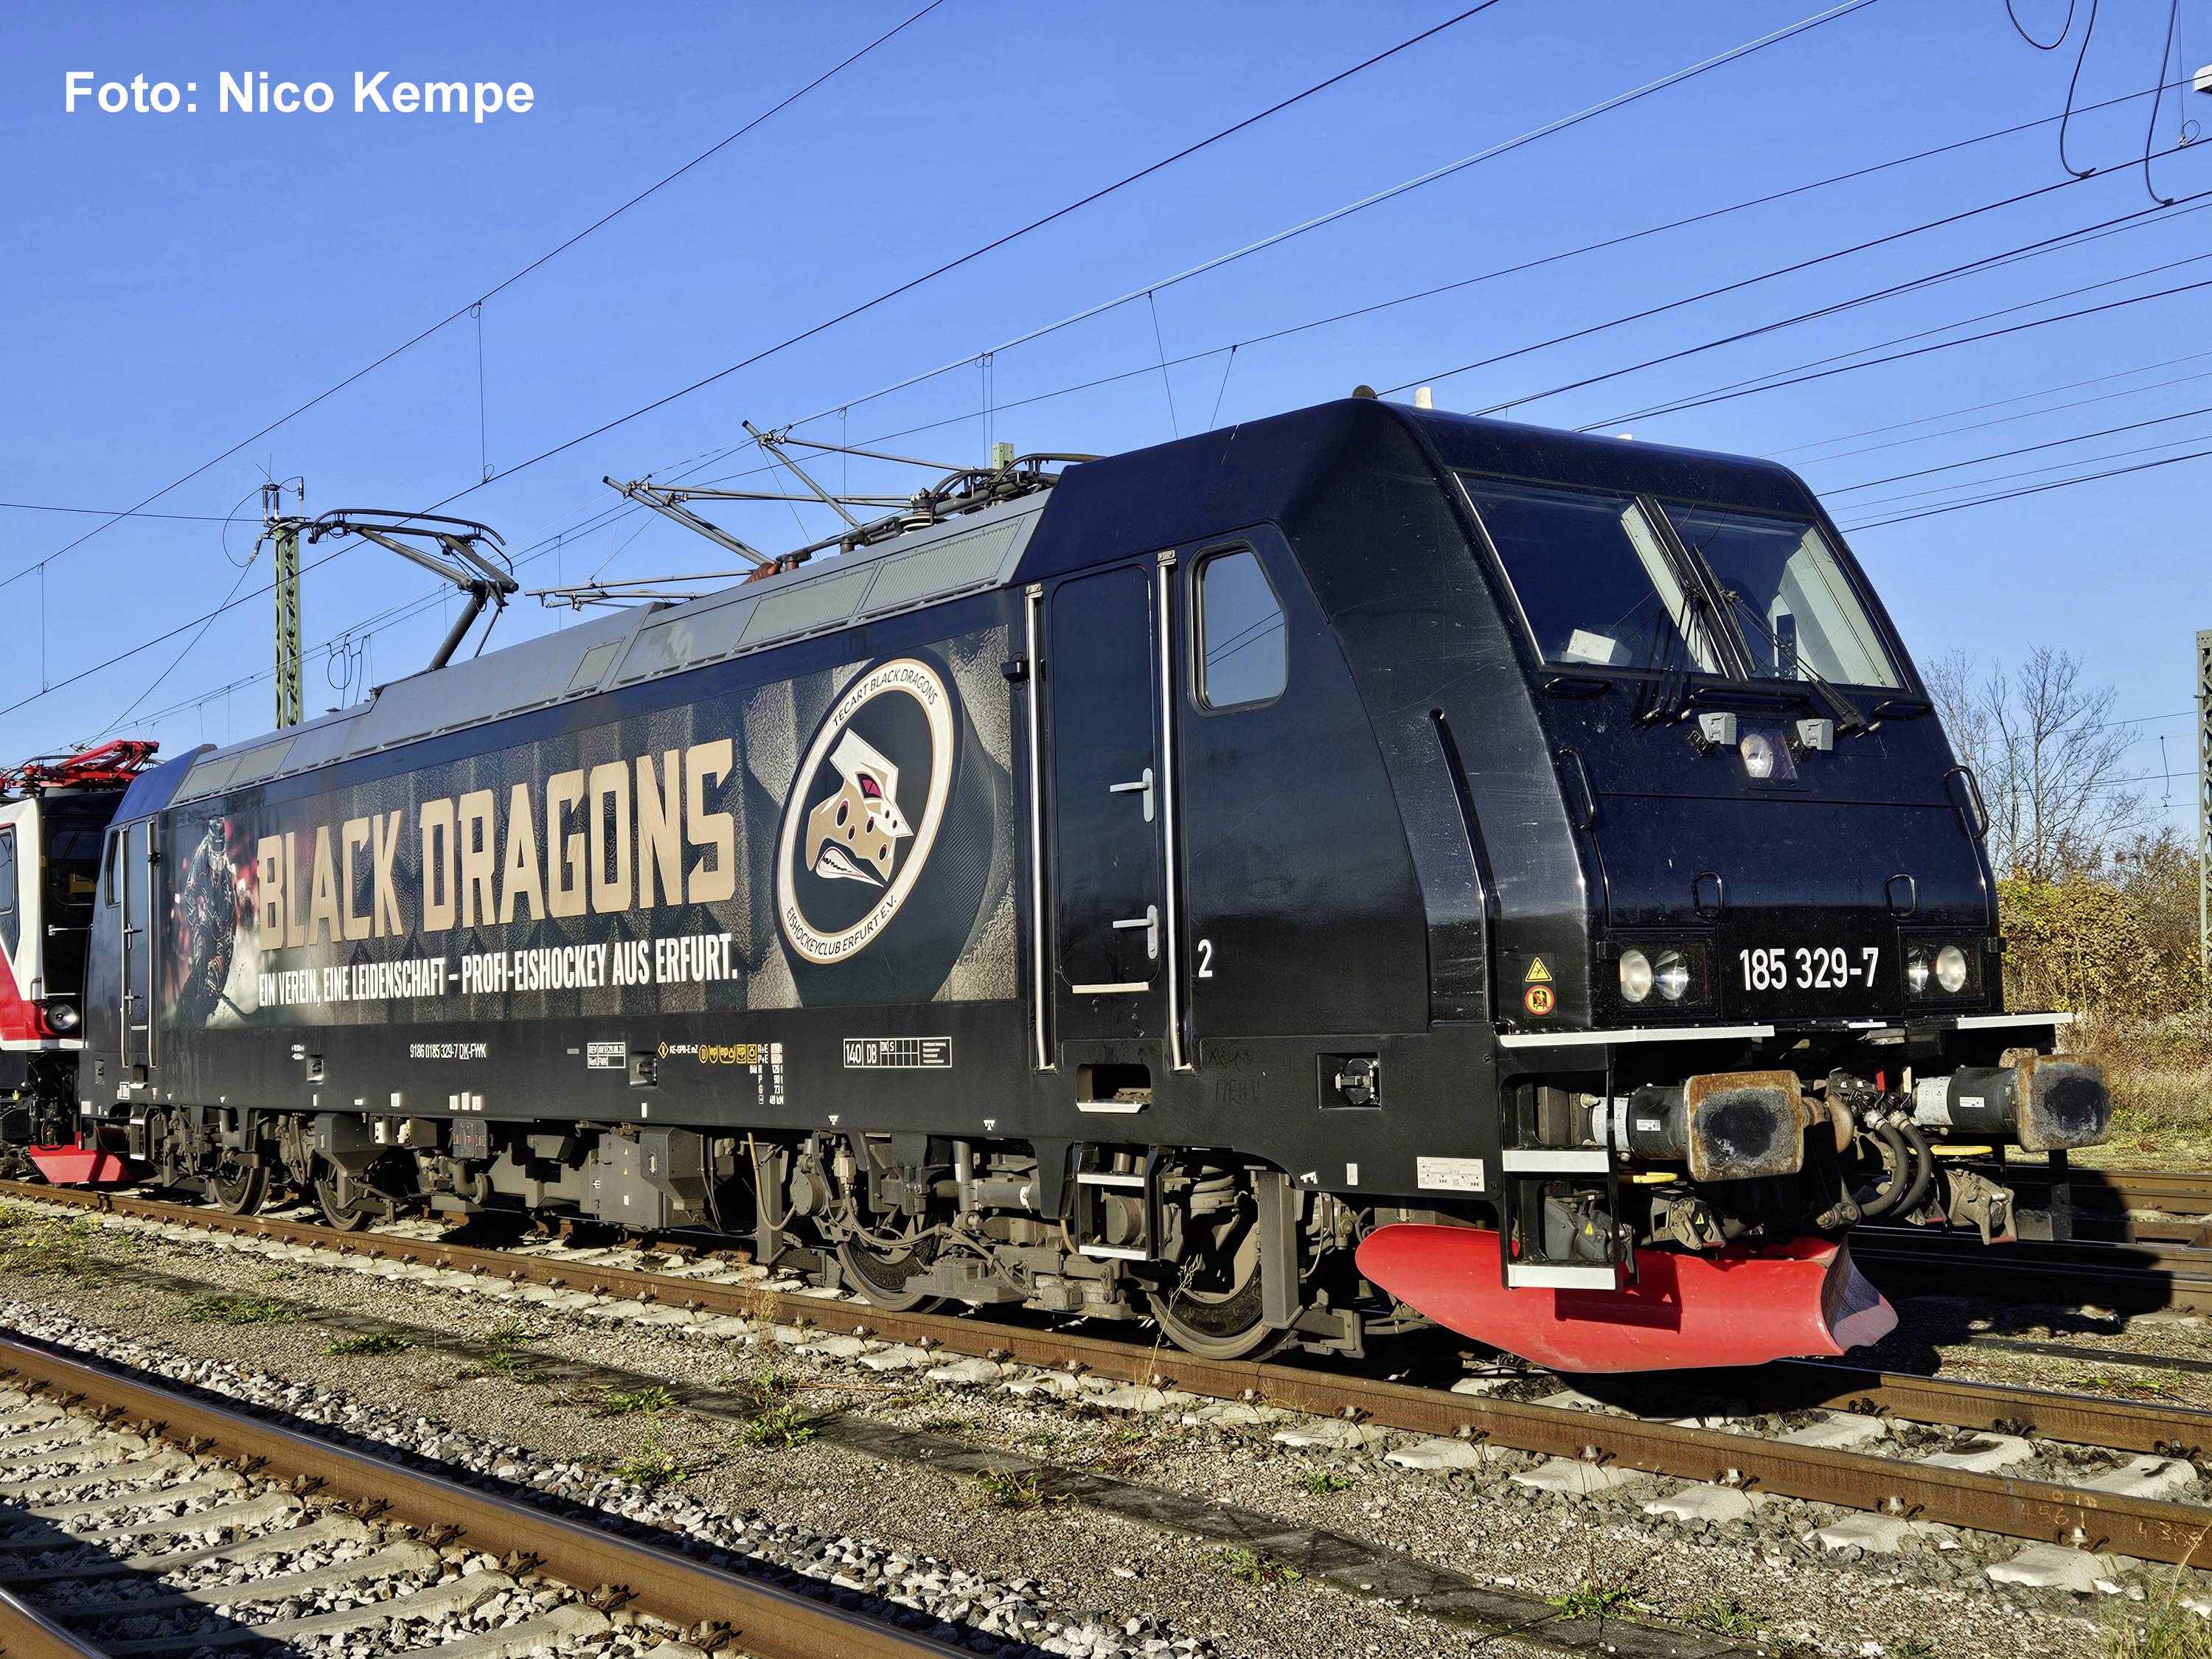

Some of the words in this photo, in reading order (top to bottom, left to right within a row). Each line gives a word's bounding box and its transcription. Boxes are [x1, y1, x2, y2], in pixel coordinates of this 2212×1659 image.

[833, 683, 869, 726] TECART
[870, 669, 901, 692] BLACK
[900, 669, 938, 706] DRAGONS
[257, 810, 403, 951] BLACK
[421, 739, 736, 932] DRAGONS
[786, 906, 841, 956] EISHOCKEYCLUB
[842, 914, 879, 952] ERFURT
[259, 973, 276, 1006] EIN
[278, 968, 321, 1007] VEREIN,
[324, 966, 349, 1002] EINE
[352, 957, 445, 1001] LEIDENSCHAFT
[462, 943, 607, 994] PROFI-EISHOCKEY
[612, 939, 650, 986] AUS
[655, 933, 738, 984] ERFURT.
[1197, 939, 1213, 978] 2
[1739, 948, 1787, 991] 185
[1795, 947, 1879, 989] 329-7
[846, 1044, 861, 1063] 140
[866, 1044, 877, 1063] DB
